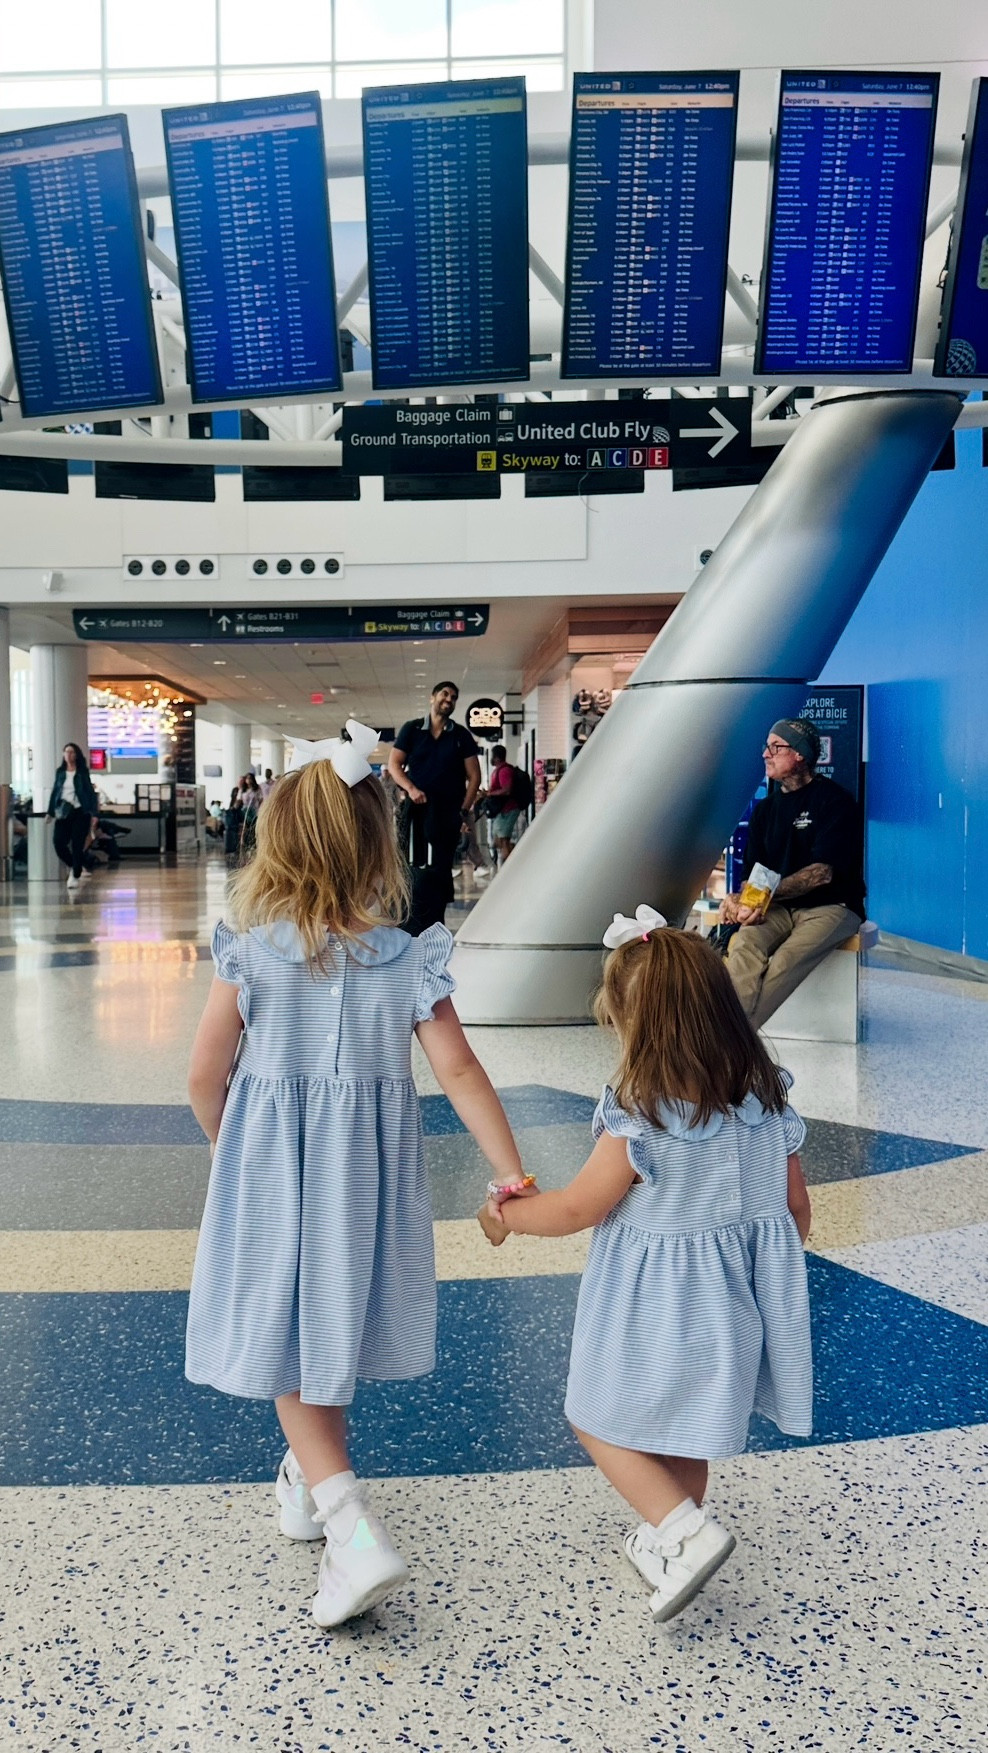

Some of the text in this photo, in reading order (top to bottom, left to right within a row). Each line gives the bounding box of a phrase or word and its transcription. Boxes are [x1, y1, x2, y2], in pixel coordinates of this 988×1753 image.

[785, 97, 820, 105] Departures
[396, 409, 491, 426] Baggage Claim
[517, 421, 650, 441] United Club Fly
[350, 432, 491, 448] Ground Transportation
[502, 450, 663, 470] Skyway to: A C D E
[269, 612, 299, 620] B21-B31
[397, 610, 450, 620] Baggage Claim
[378, 623, 408, 632] Skyway
[424, 622, 431, 630] A
[435, 622, 441, 630] C
[445, 622, 452, 630] D
[803, 698, 835, 708] XPLORE
[815, 709, 826, 718] AT
